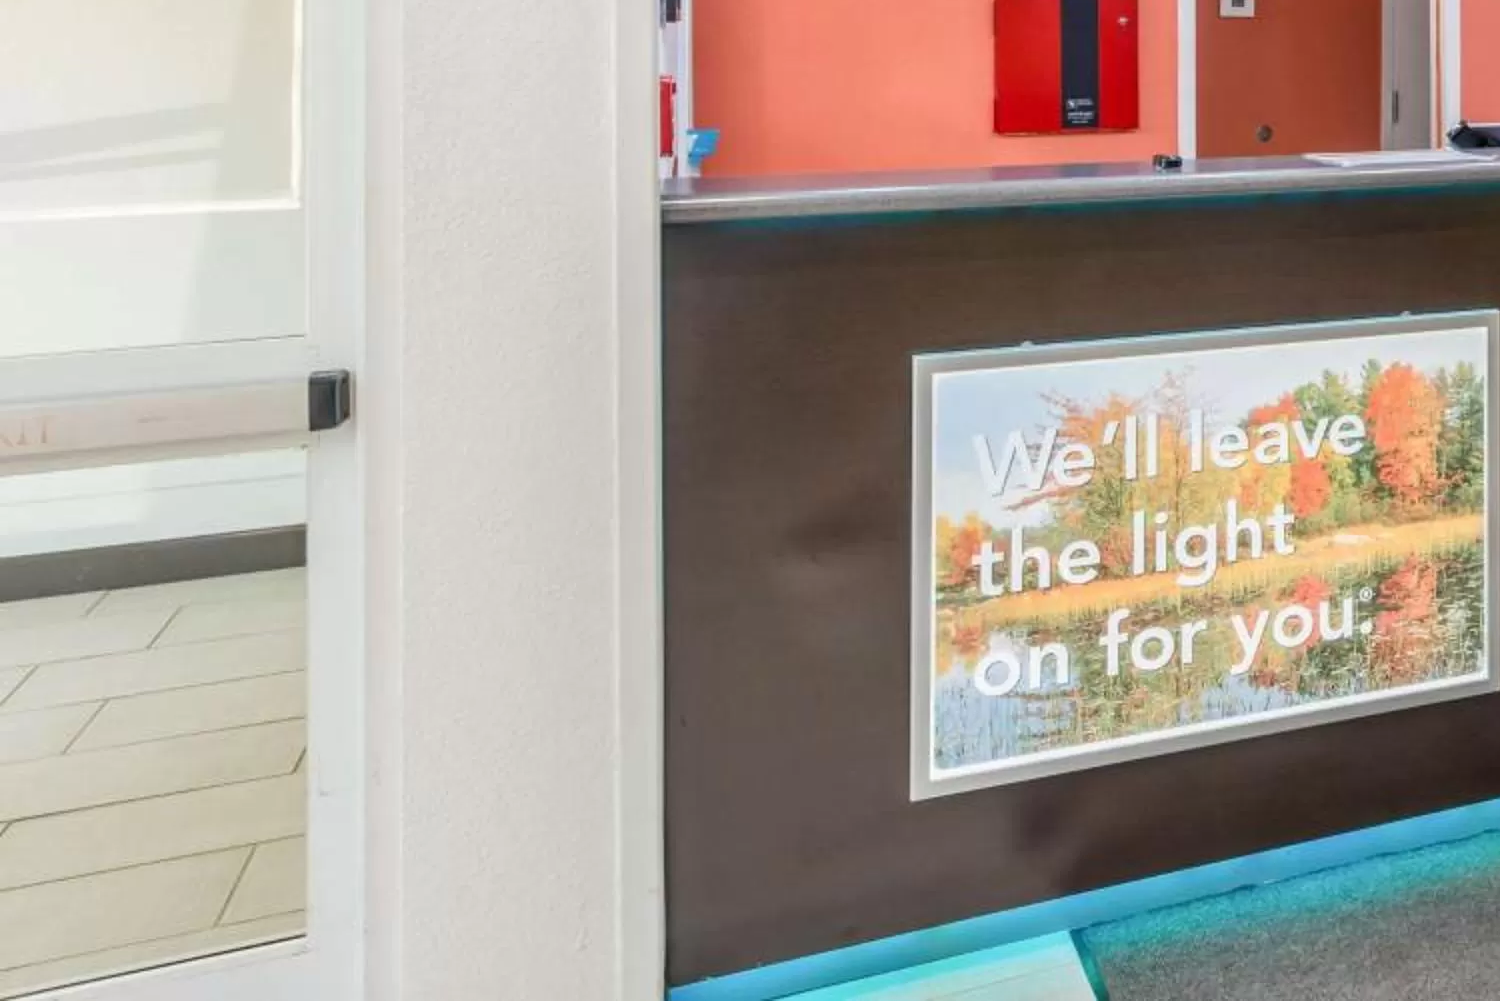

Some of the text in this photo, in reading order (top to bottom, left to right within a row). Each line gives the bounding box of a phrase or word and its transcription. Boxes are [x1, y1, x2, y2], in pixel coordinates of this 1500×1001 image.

[972, 408, 1366, 496] We'll leave
[971, 498, 1297, 597] the light
[973, 634, 1071, 696] on
[1100, 608, 1207, 676] for
